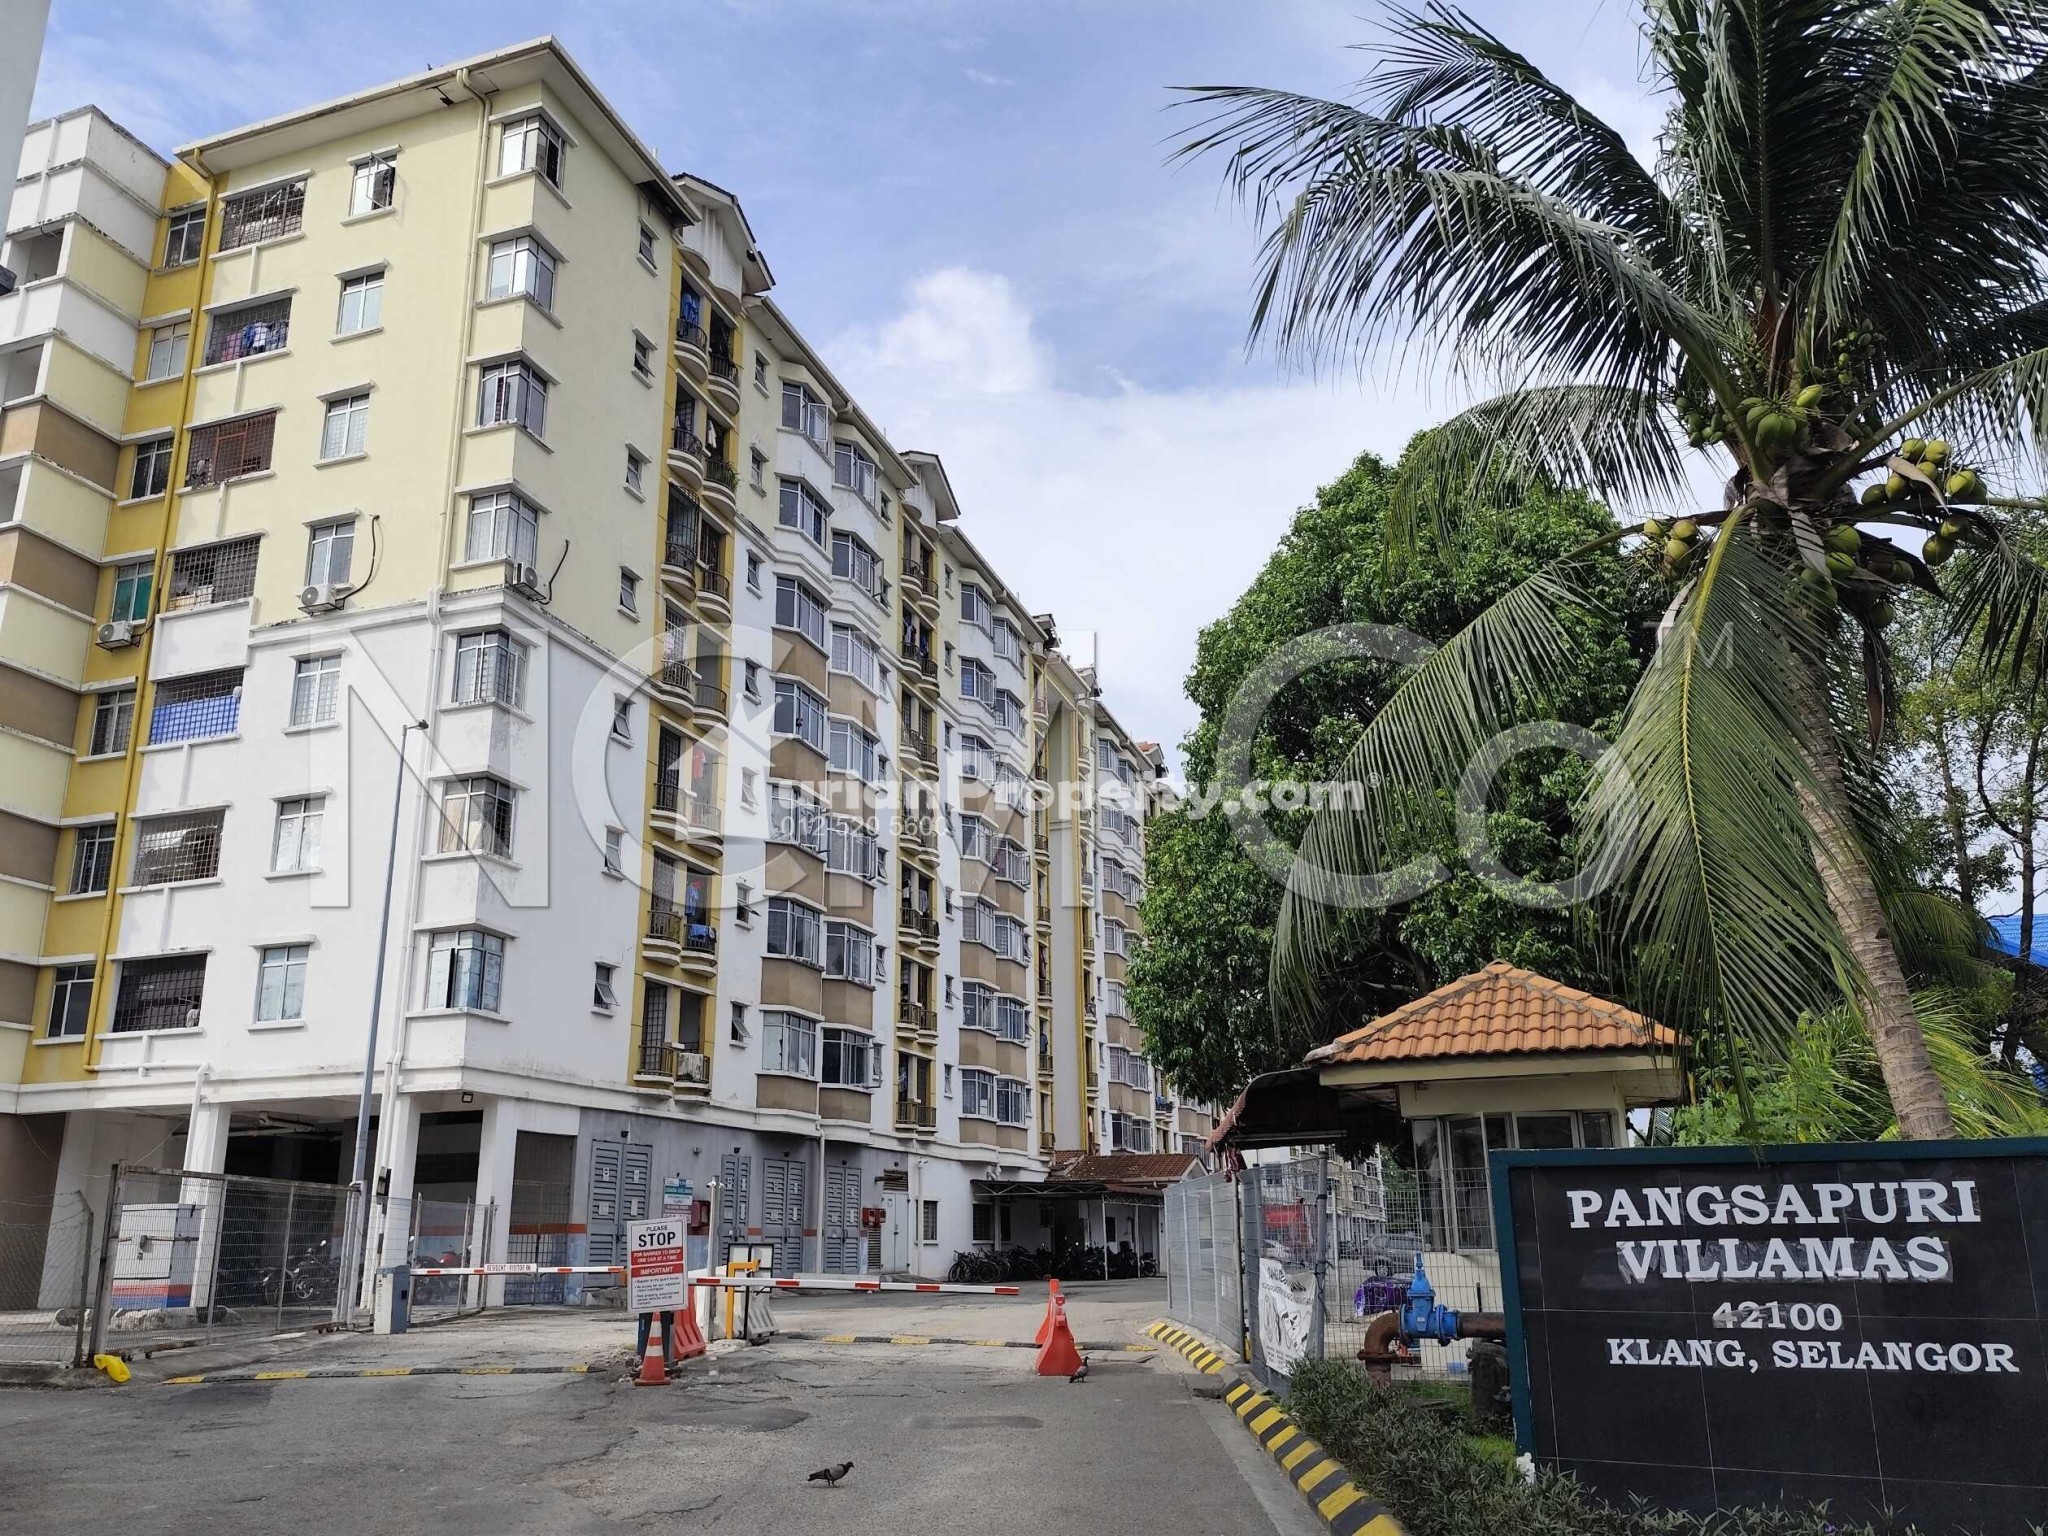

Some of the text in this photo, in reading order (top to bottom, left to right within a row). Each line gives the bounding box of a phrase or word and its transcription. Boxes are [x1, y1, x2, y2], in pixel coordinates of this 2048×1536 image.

[1566, 1180, 1981, 1229] PANGSAPURI
[638, 1231, 676, 1248] STOP
[646, 1224, 668, 1232] PLEASE
[640, 1266, 674, 1275] IMPORTANT
[1617, 1236, 1950, 1281] VILLAMAS
[1712, 1300, 1842, 1331] 42100
[1607, 1338, 2019, 1373] KLANG, SELANGOR
